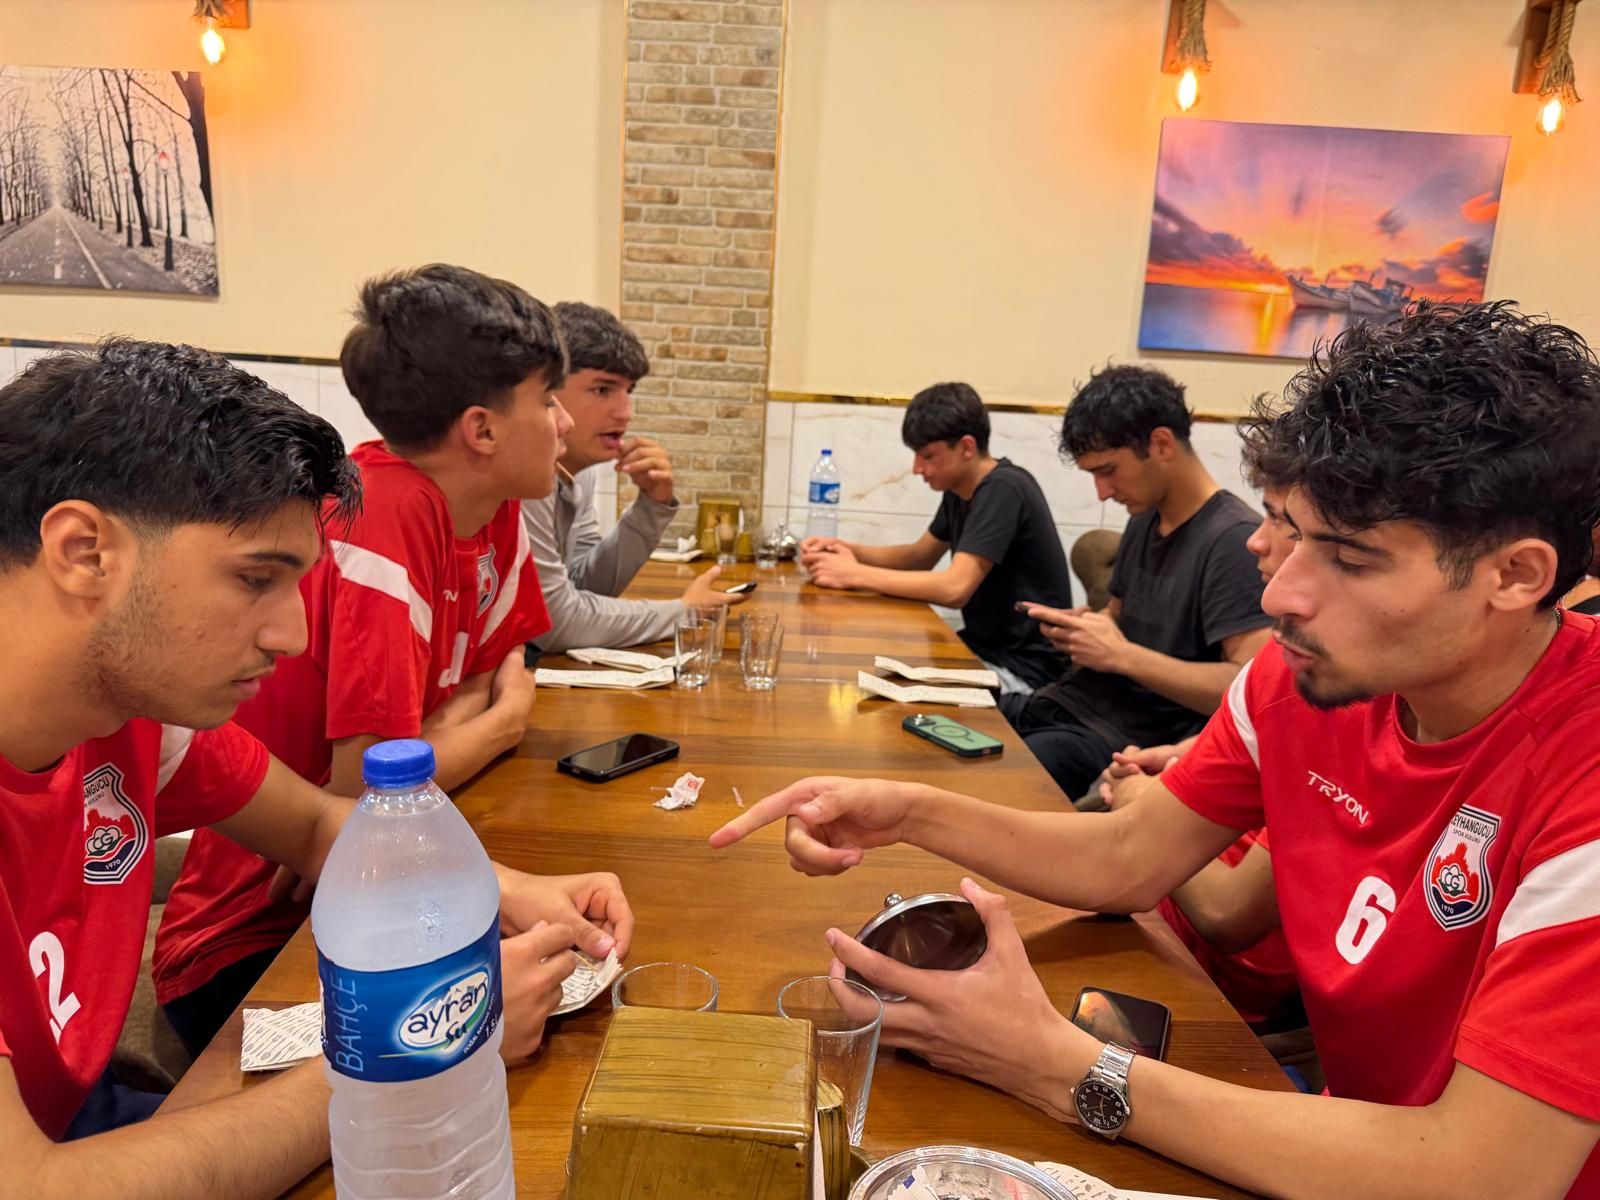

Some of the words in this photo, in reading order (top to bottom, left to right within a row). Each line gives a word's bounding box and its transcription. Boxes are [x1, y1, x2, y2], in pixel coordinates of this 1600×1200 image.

[1308, 769, 1369, 824] TRYON
[1451, 814, 1492, 838] EYHANGÜCÜ
[105, 858, 121, 870] 1970
[1335, 876, 1396, 964] 6
[1441, 903, 1454, 914] 1970
[29, 931, 81, 1046] 2
[408, 979, 488, 1038] ayran
[331, 972, 368, 1072] BAHÇE
